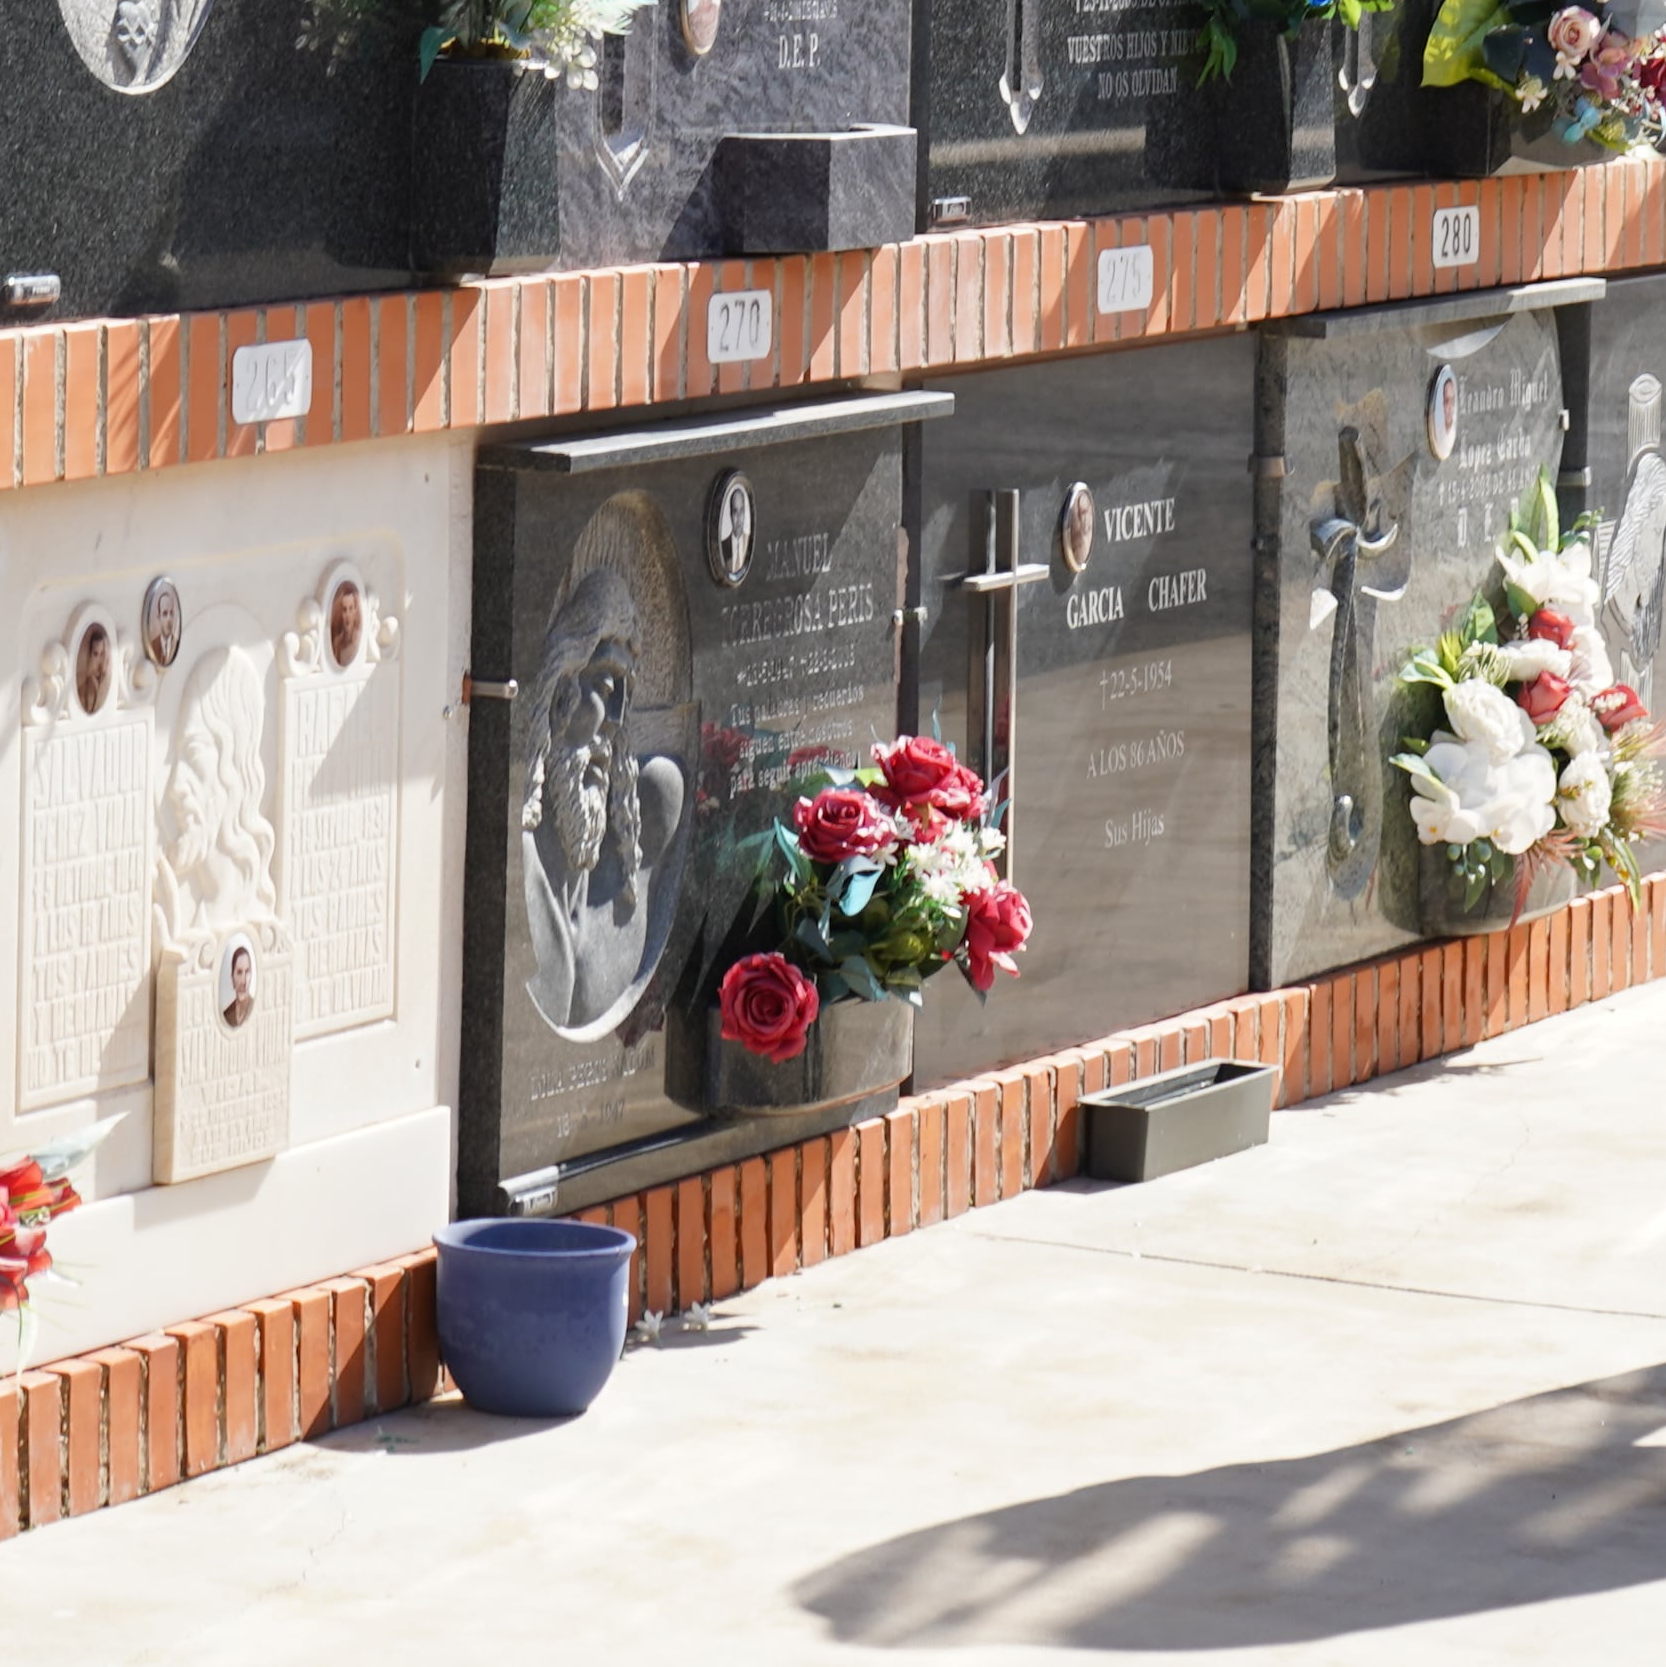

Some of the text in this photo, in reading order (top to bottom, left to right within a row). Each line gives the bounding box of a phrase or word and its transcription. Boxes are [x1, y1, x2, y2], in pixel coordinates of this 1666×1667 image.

[1068, 34, 1123, 64] VUESTROS
[1098, 67, 1177, 99] NO OS OLVIDAN
[1442, 213, 1471, 258] 280
[1106, 251, 1141, 303] 275
[719, 298, 761, 353] 270
[1103, 498, 1175, 542] VICENTE
[828, 583, 873, 628] PERIS
[1067, 568, 1207, 630] GARCIA CHAFER
[1086, 752, 1098, 780] A
[1100, 743, 1127, 776] LOS
[1147, 730, 1184, 762] AÑOS
[1104, 809, 1164, 849] Sus Hijas
